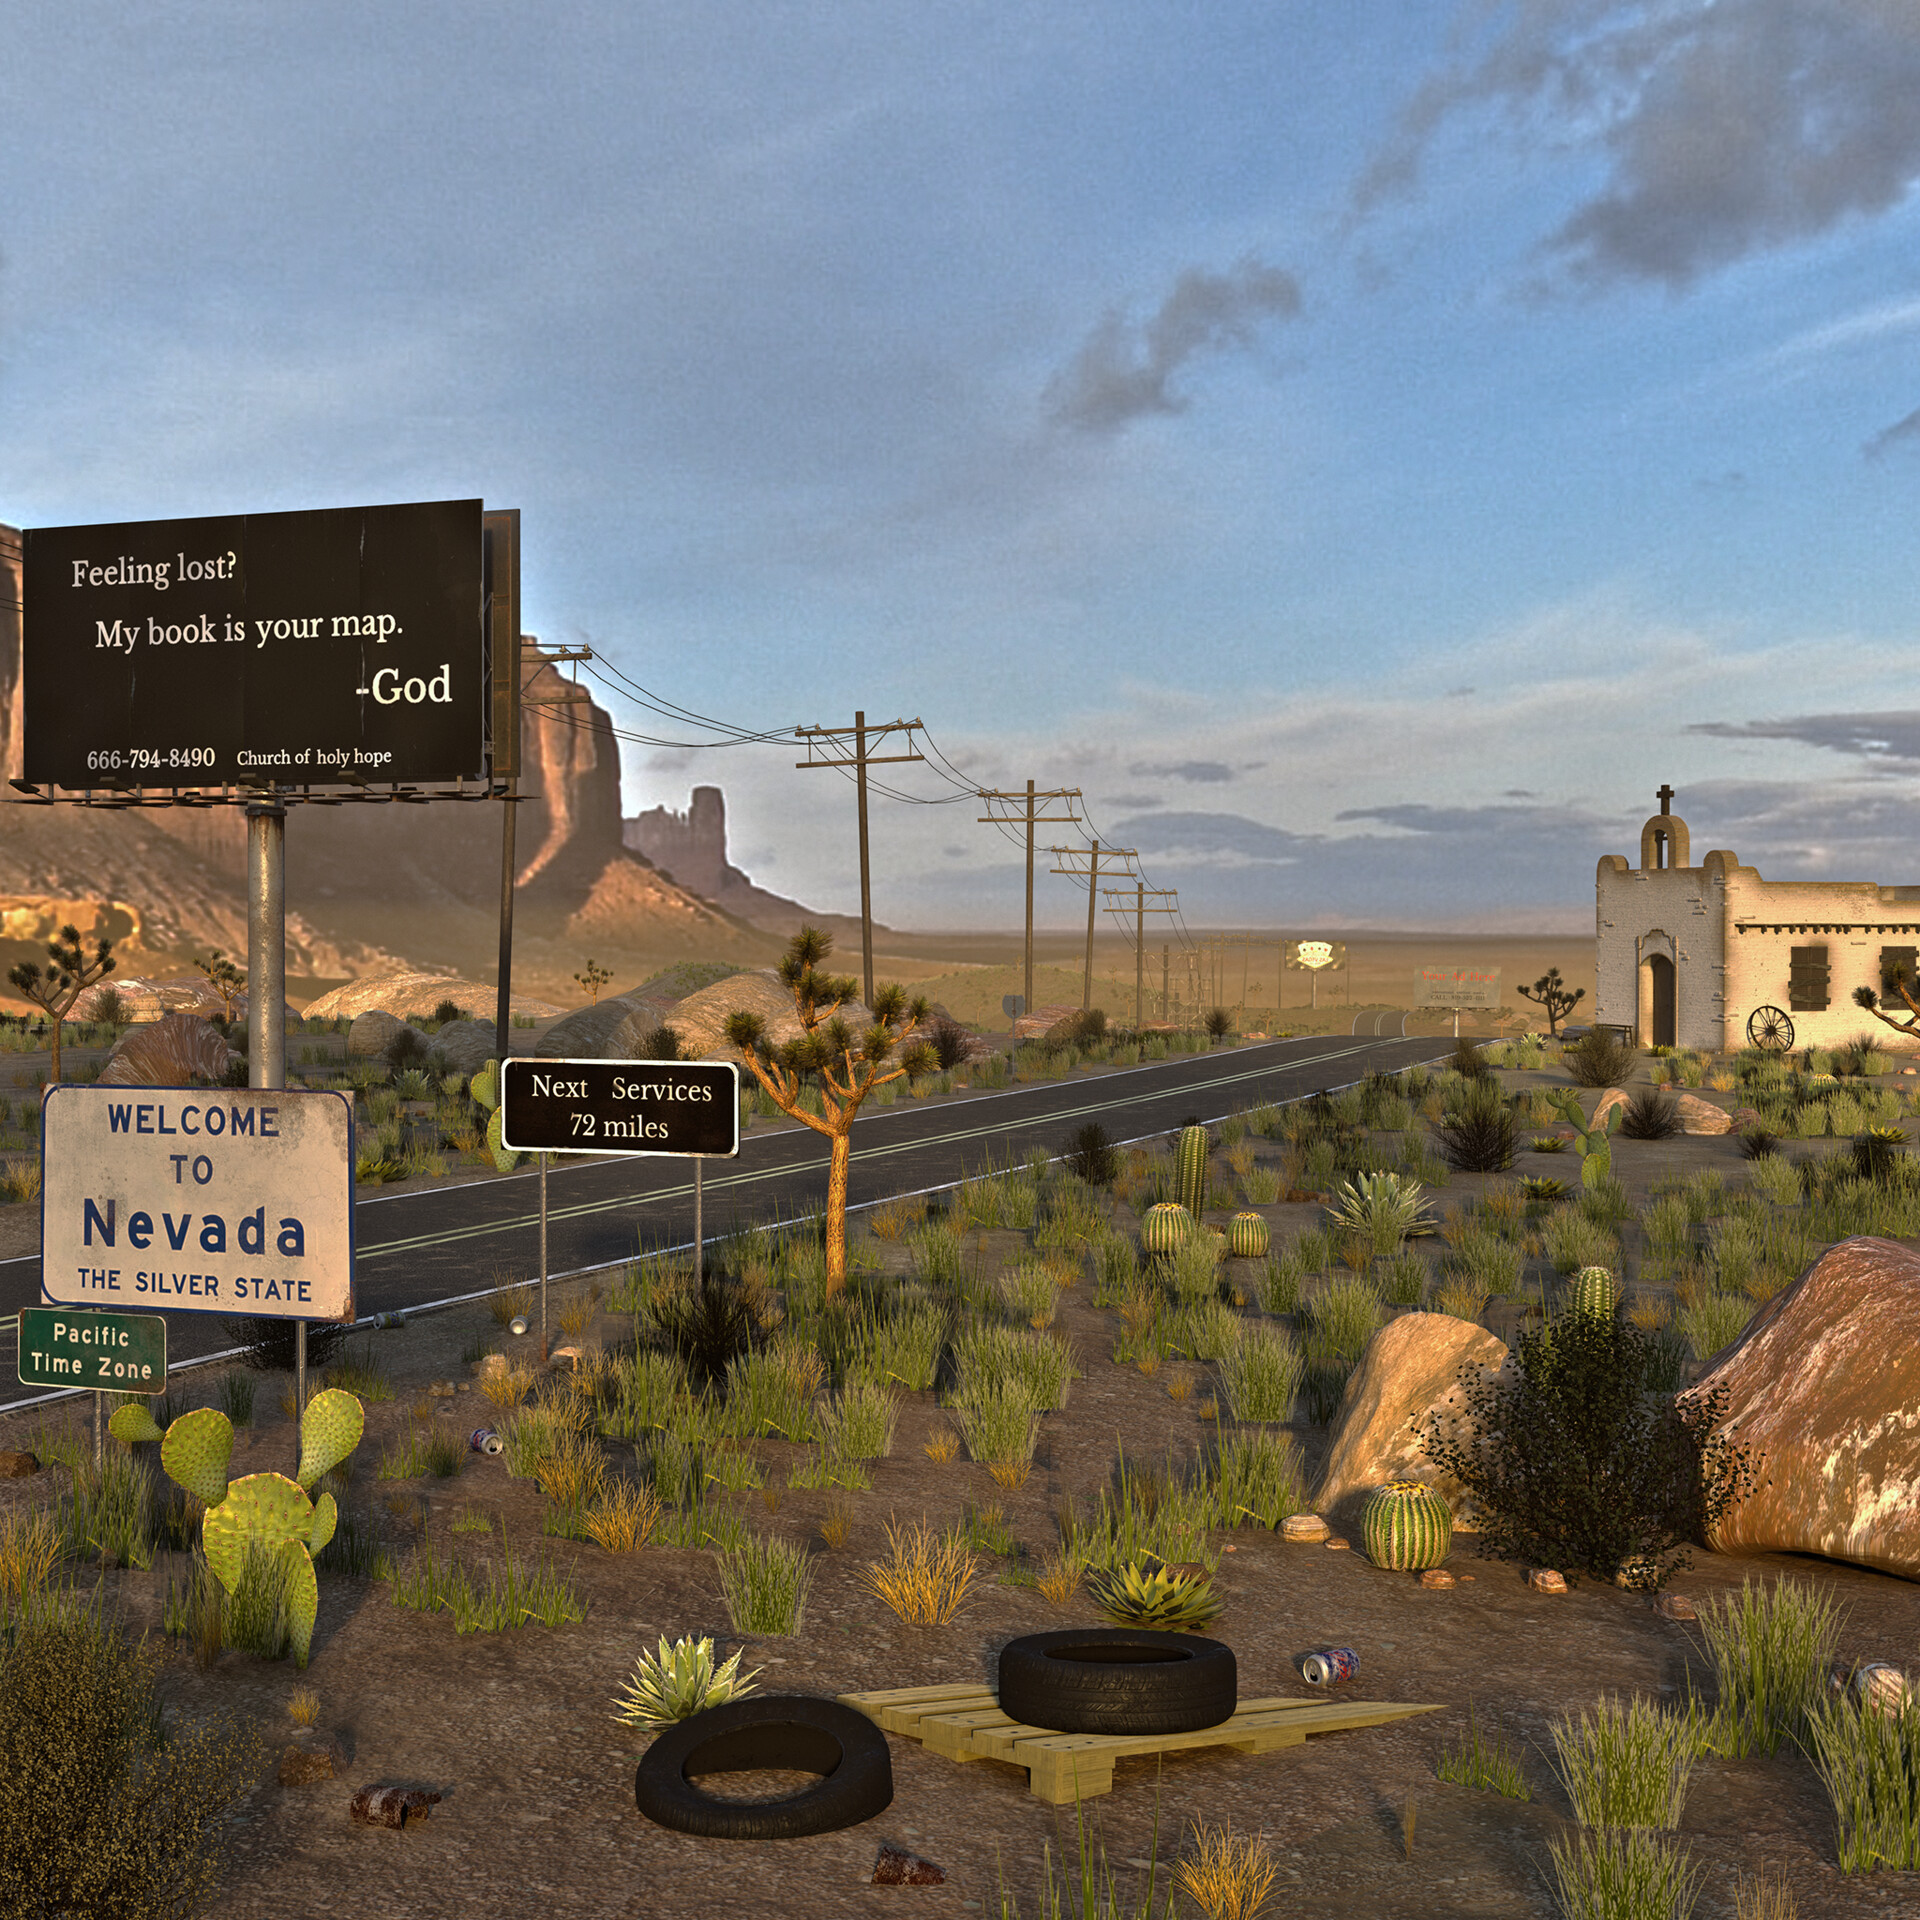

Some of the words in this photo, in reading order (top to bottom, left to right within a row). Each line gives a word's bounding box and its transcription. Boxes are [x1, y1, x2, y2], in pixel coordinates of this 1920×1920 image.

[72, 556, 171, 590] Feeling
[177, 551, 236, 581] lost?
[96, 620, 140, 654] My
[147, 614, 217, 645] book
[224, 614, 245, 641] is
[255, 618, 323, 648] your
[331, 614, 403, 643] map.
[356, 664, 453, 705] -God
[88, 748, 215, 769] 666-794-8490
[237, 749, 291, 765] Church
[295, 748, 311, 764] of
[317, 748, 350, 768] holy
[354, 748, 392, 767] hope
[1421, 970, 1447, 981] Your
[1450, 971, 1466, 982] Ad
[1470, 971, 1496, 982] Here
[532, 1075, 588, 1098] Next
[612, 1077, 712, 1101] Services
[108, 1104, 279, 1136] WELCOME
[571, 1113, 595, 1136] 72
[604, 1114, 668, 1138] miles
[170, 1155, 212, 1184] TO
[84, 1199, 304, 1256] Nevada
[78, 1268, 120, 1290] THE
[136, 1272, 218, 1296] SILVER
[235, 1278, 311, 1301] STATE
[54, 1323, 128, 1347] Pacific
[32, 1352, 82, 1374] Time
[99, 1357, 151, 1379] Zone
